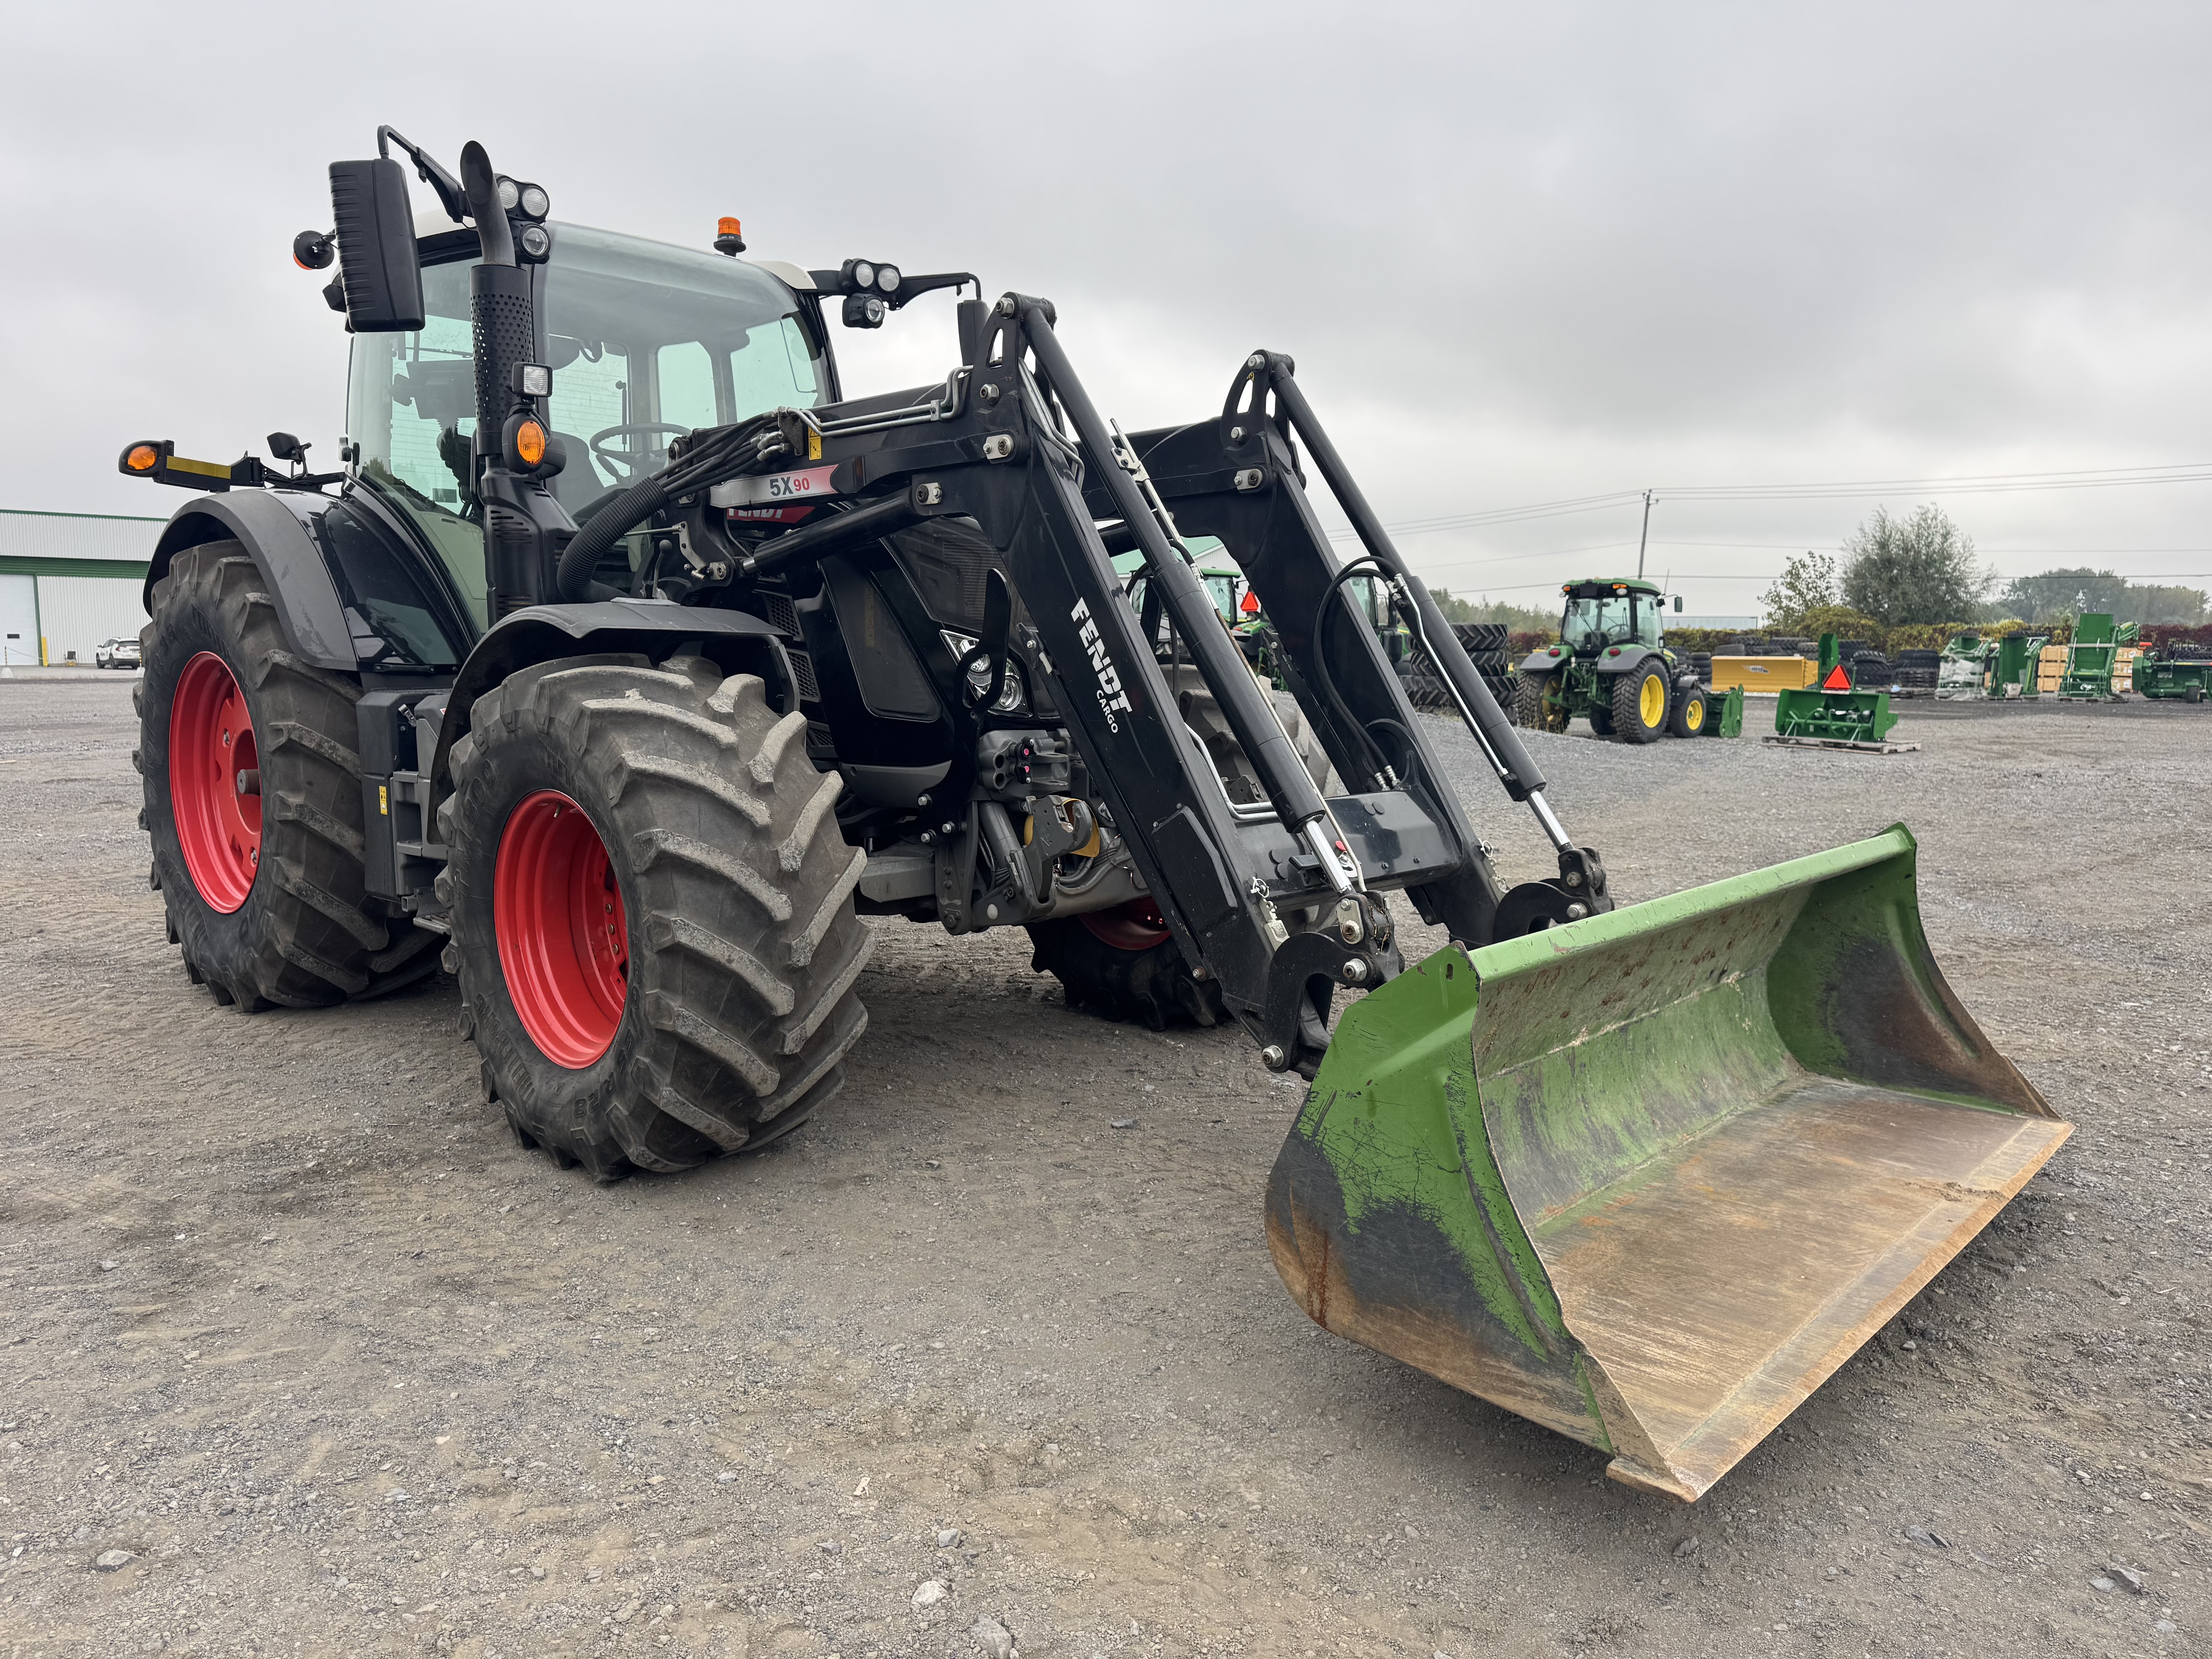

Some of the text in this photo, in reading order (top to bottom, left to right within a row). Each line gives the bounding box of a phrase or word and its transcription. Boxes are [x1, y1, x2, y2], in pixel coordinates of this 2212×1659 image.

[769, 476, 810, 496] 5X90
[1071, 597, 1132, 712] FENDT
[1096, 690, 1118, 733] CARGO
